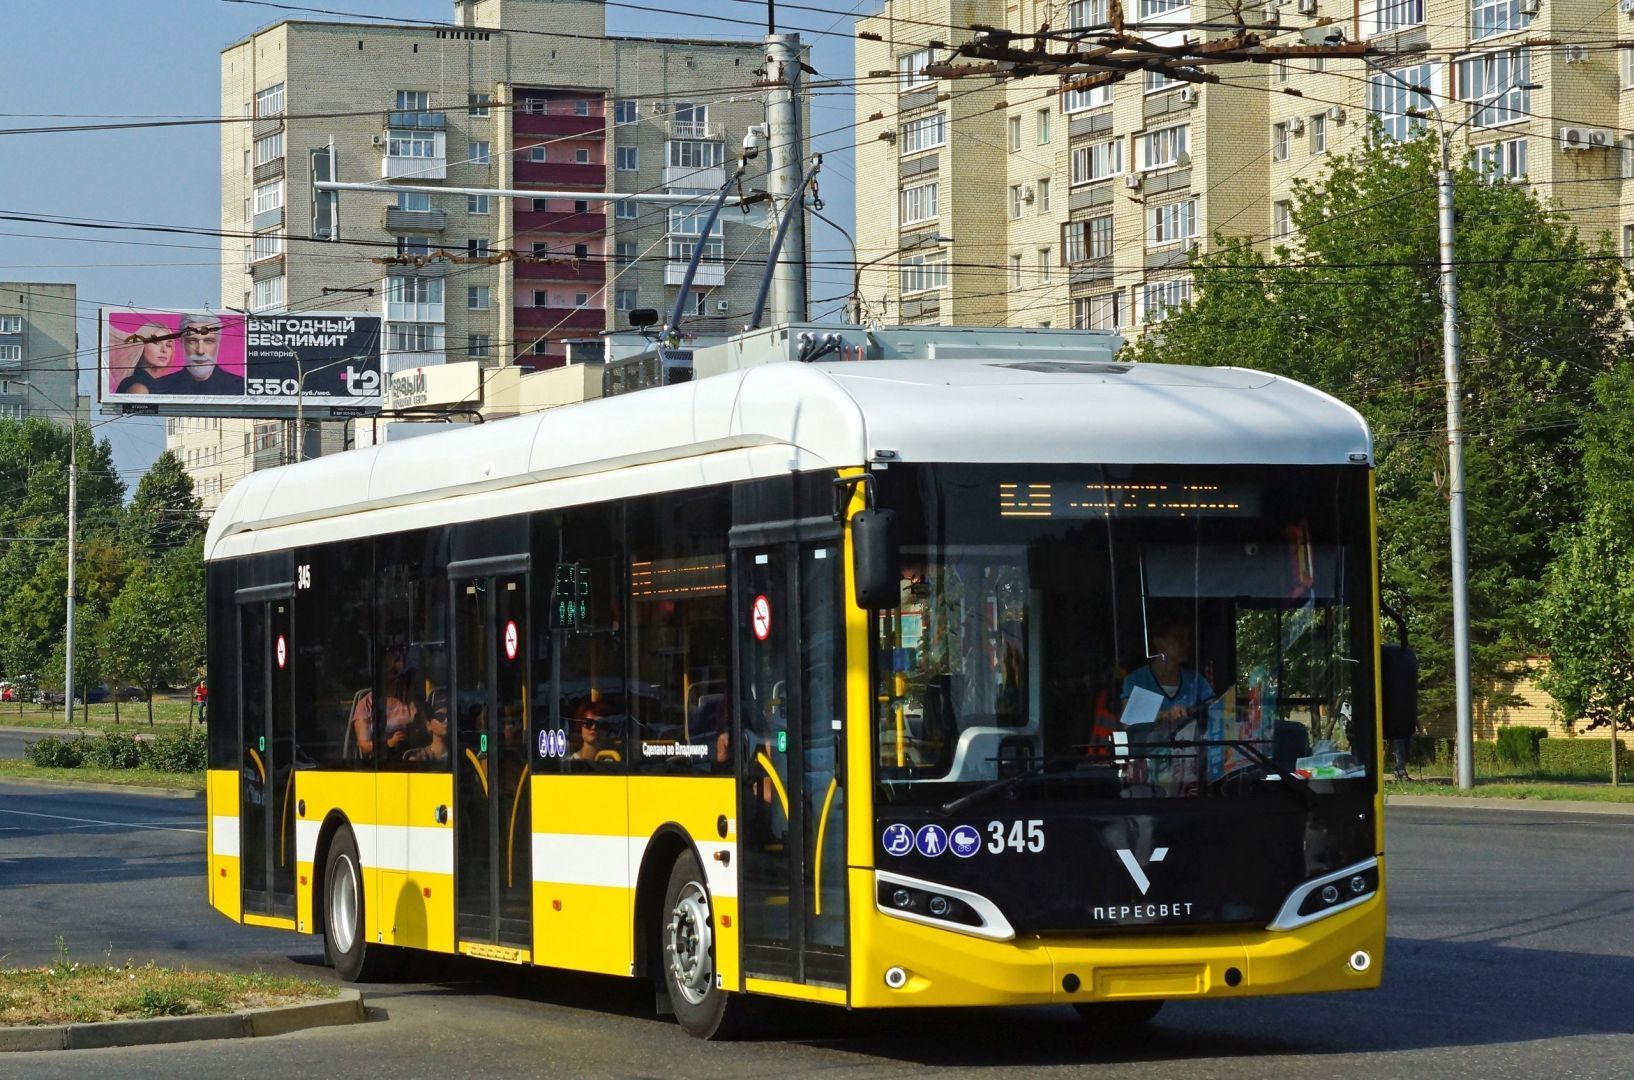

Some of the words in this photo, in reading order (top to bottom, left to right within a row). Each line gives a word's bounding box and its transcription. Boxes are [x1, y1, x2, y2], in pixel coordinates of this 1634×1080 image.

[248, 317, 355, 334] ВЫГОДНЫЙ
[247, 379, 299, 395] 350
[340, 366, 380, 395] t2
[298, 564, 310, 589] 345
[642, 742, 666, 757] Сделано
[667, 745, 674, 755] во
[675, 742, 708, 758] Владимире
[987, 819, 1045, 854] 345
[1094, 902, 1193, 919] ПЕРЕСВЕТ
